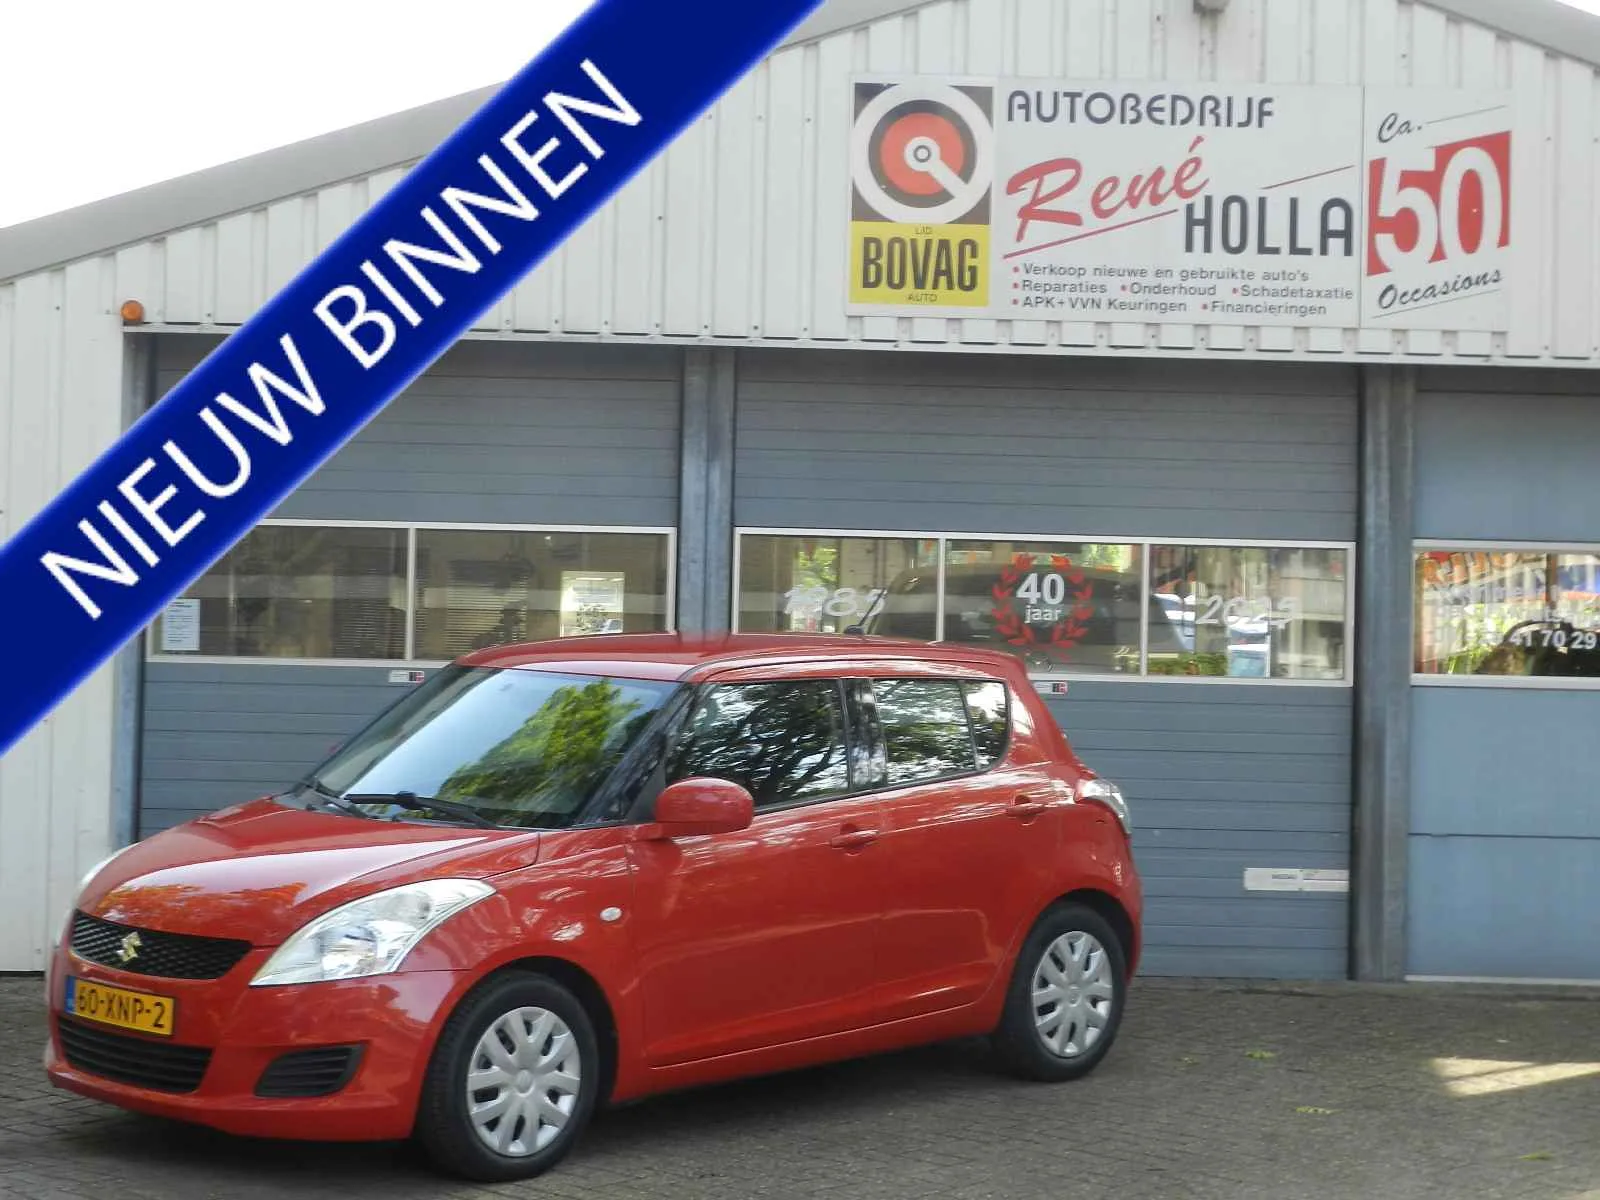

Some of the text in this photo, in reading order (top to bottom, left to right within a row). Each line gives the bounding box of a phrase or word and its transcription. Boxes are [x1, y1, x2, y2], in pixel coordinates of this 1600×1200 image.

[1007, 90, 1275, 129] AUTOBEDRIJF
[1377, 112, 1424, 143] Ca.
[1005, 135, 1210, 243] René
[1371, 137, 1506, 275] 50
[1184, 194, 1355, 257] HOLLA
[862, 236, 979, 292] BOVAG
[1023, 263, 1309, 281] Verkoop nieuwe en gebruikte auto's
[907, 293, 938, 302] AUTO
[1022, 279, 1107, 293] Reparaties
[1129, 282, 1217, 295] Onderhoud
[1240, 284, 1354, 299] Schadetaxatie
[1378, 268, 1504, 310] Occasions
[1108, 298, 1187, 313] Keuringen
[1211, 300, 1327, 316] Financieringen
[1015, 573, 1065, 605] 40
[1024, 604, 1062, 623] jaar
[1540, 629, 1567, 648] 70
[1571, 631, 1597, 649] 29
[78, 986, 165, 1029] 60-XNP-2
